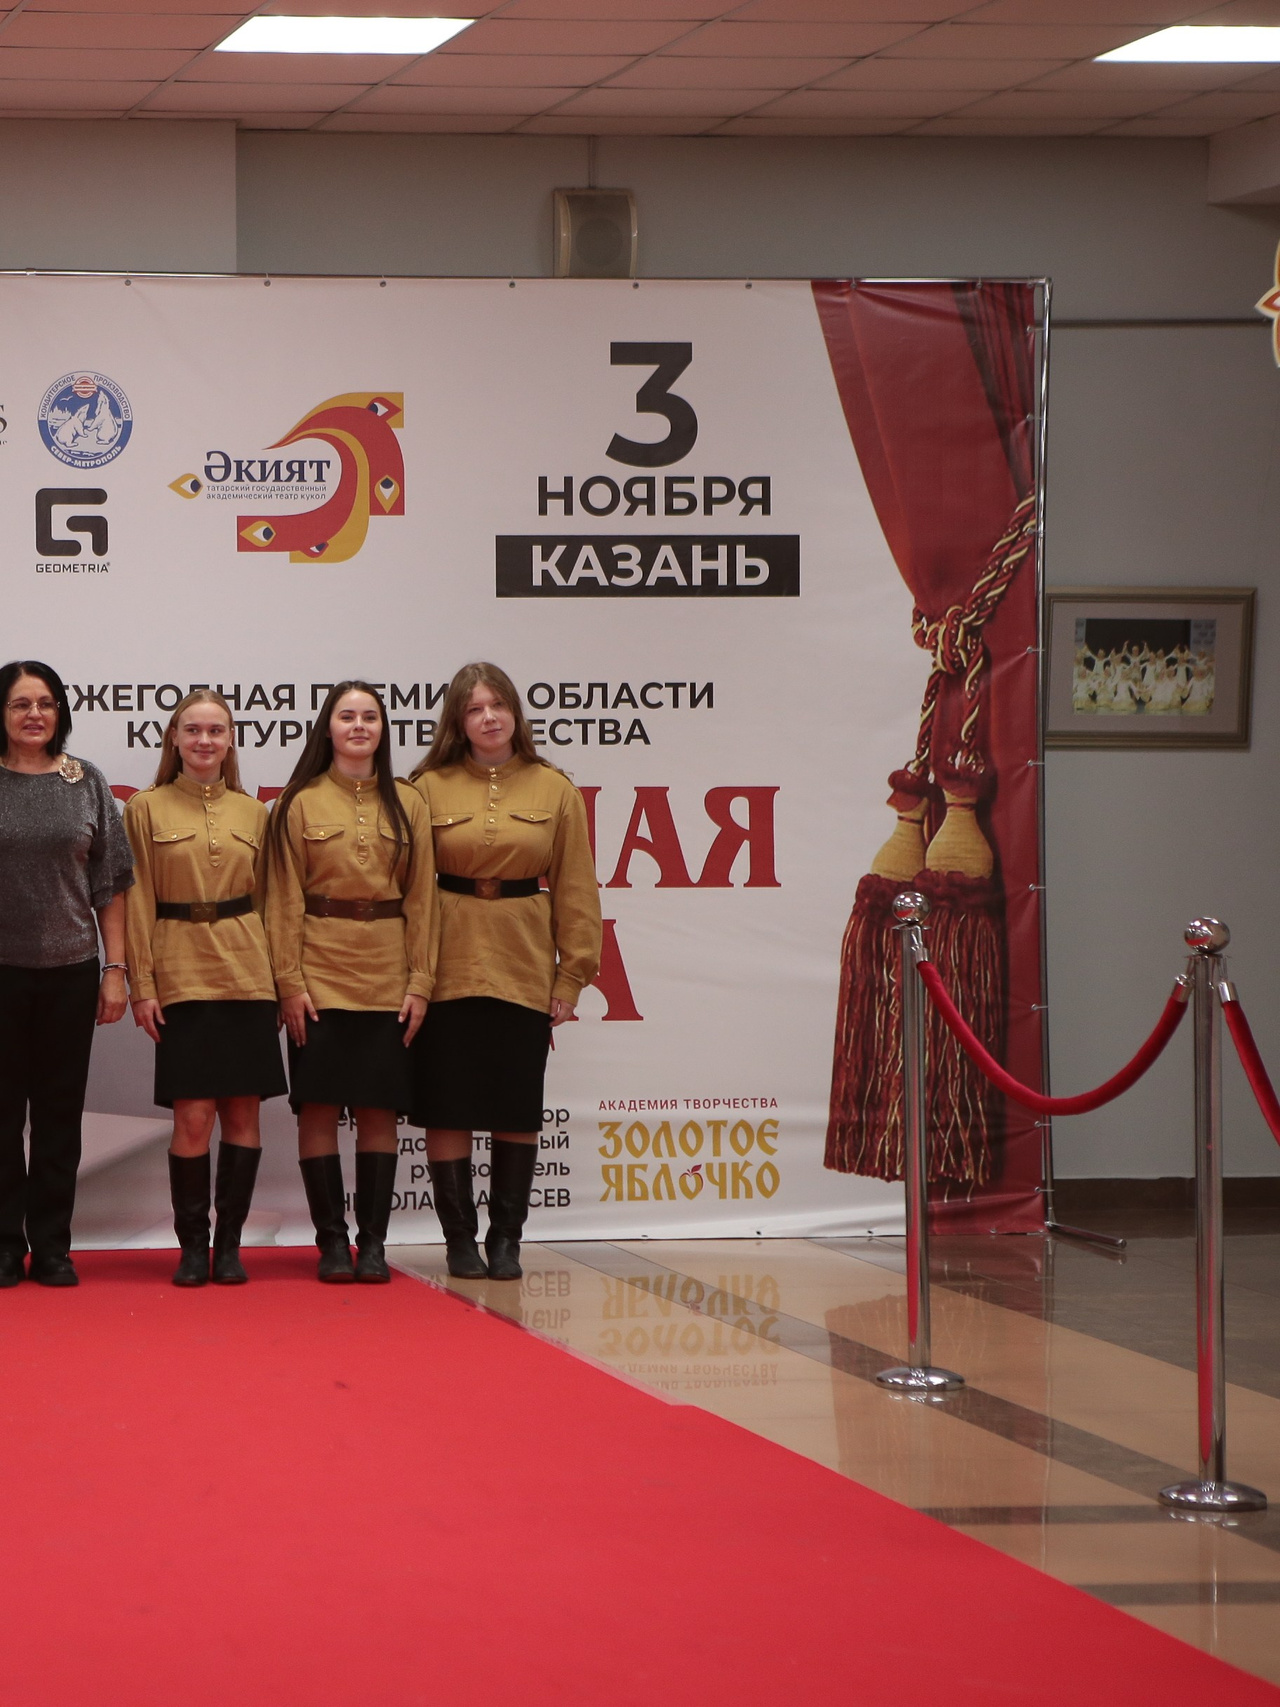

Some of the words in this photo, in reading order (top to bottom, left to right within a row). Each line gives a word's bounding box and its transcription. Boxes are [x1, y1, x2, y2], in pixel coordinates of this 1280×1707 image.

[40, 374, 75, 418] КОНДИТЕРСКОЕ
[93, 374, 131, 419] ПРОИЗВОДСТВО
[605, 342, 698, 468] 3
[50, 446, 122, 467] СЕВЕР-МЕТРОПОЛЬ
[207, 484, 250, 493] татарский
[251, 484, 327, 493] государственный
[207, 493, 273, 501] академический
[275, 493, 299, 501] театр
[300, 493, 326, 501] кукол
[537, 475, 771, 516] НОЯБРЯ
[531, 544, 771, 587] КАЗАНЬ
[64, 683, 296, 712] ЖЕГОНАЯ
[526, 682, 715, 710] ОБЛАСТИ
[598, 1100, 678, 1113] АКАДЕМИЯ
[684, 1098, 779, 1110] ТВОРЧЕСТВА
[598, 1118, 780, 1159] ЗОЛОТОЕ
[599, 1160, 781, 1202] ЯБЛОЧКО
